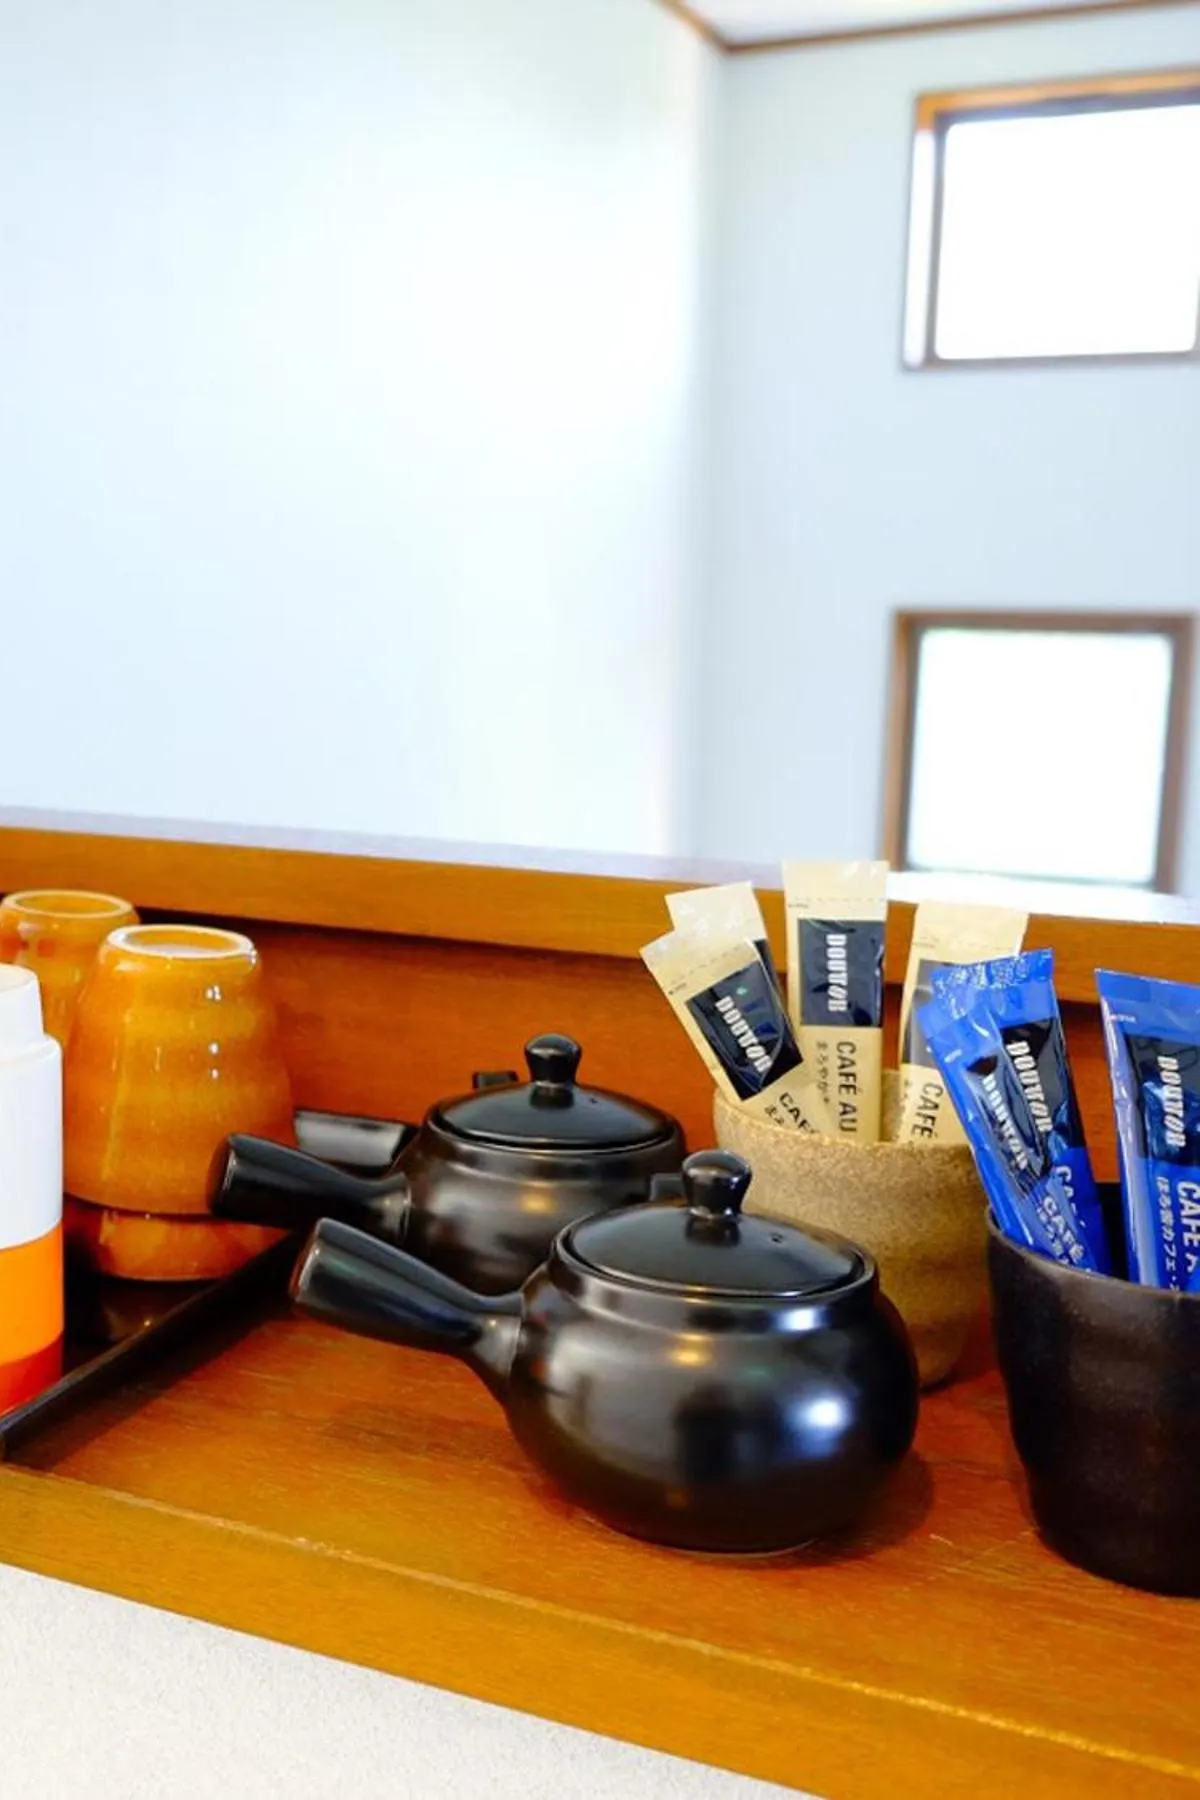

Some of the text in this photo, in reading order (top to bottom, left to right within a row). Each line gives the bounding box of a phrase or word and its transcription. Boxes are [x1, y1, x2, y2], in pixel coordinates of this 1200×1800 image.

[827, 934, 848, 1012] DOUTOR
[715, 996, 773, 1072] DOUTOR
[838, 1101, 857, 1133] AU
[1006, 1041, 1053, 1132] DOUTOR
[1157, 1055, 1186, 1147] DOUTOR
